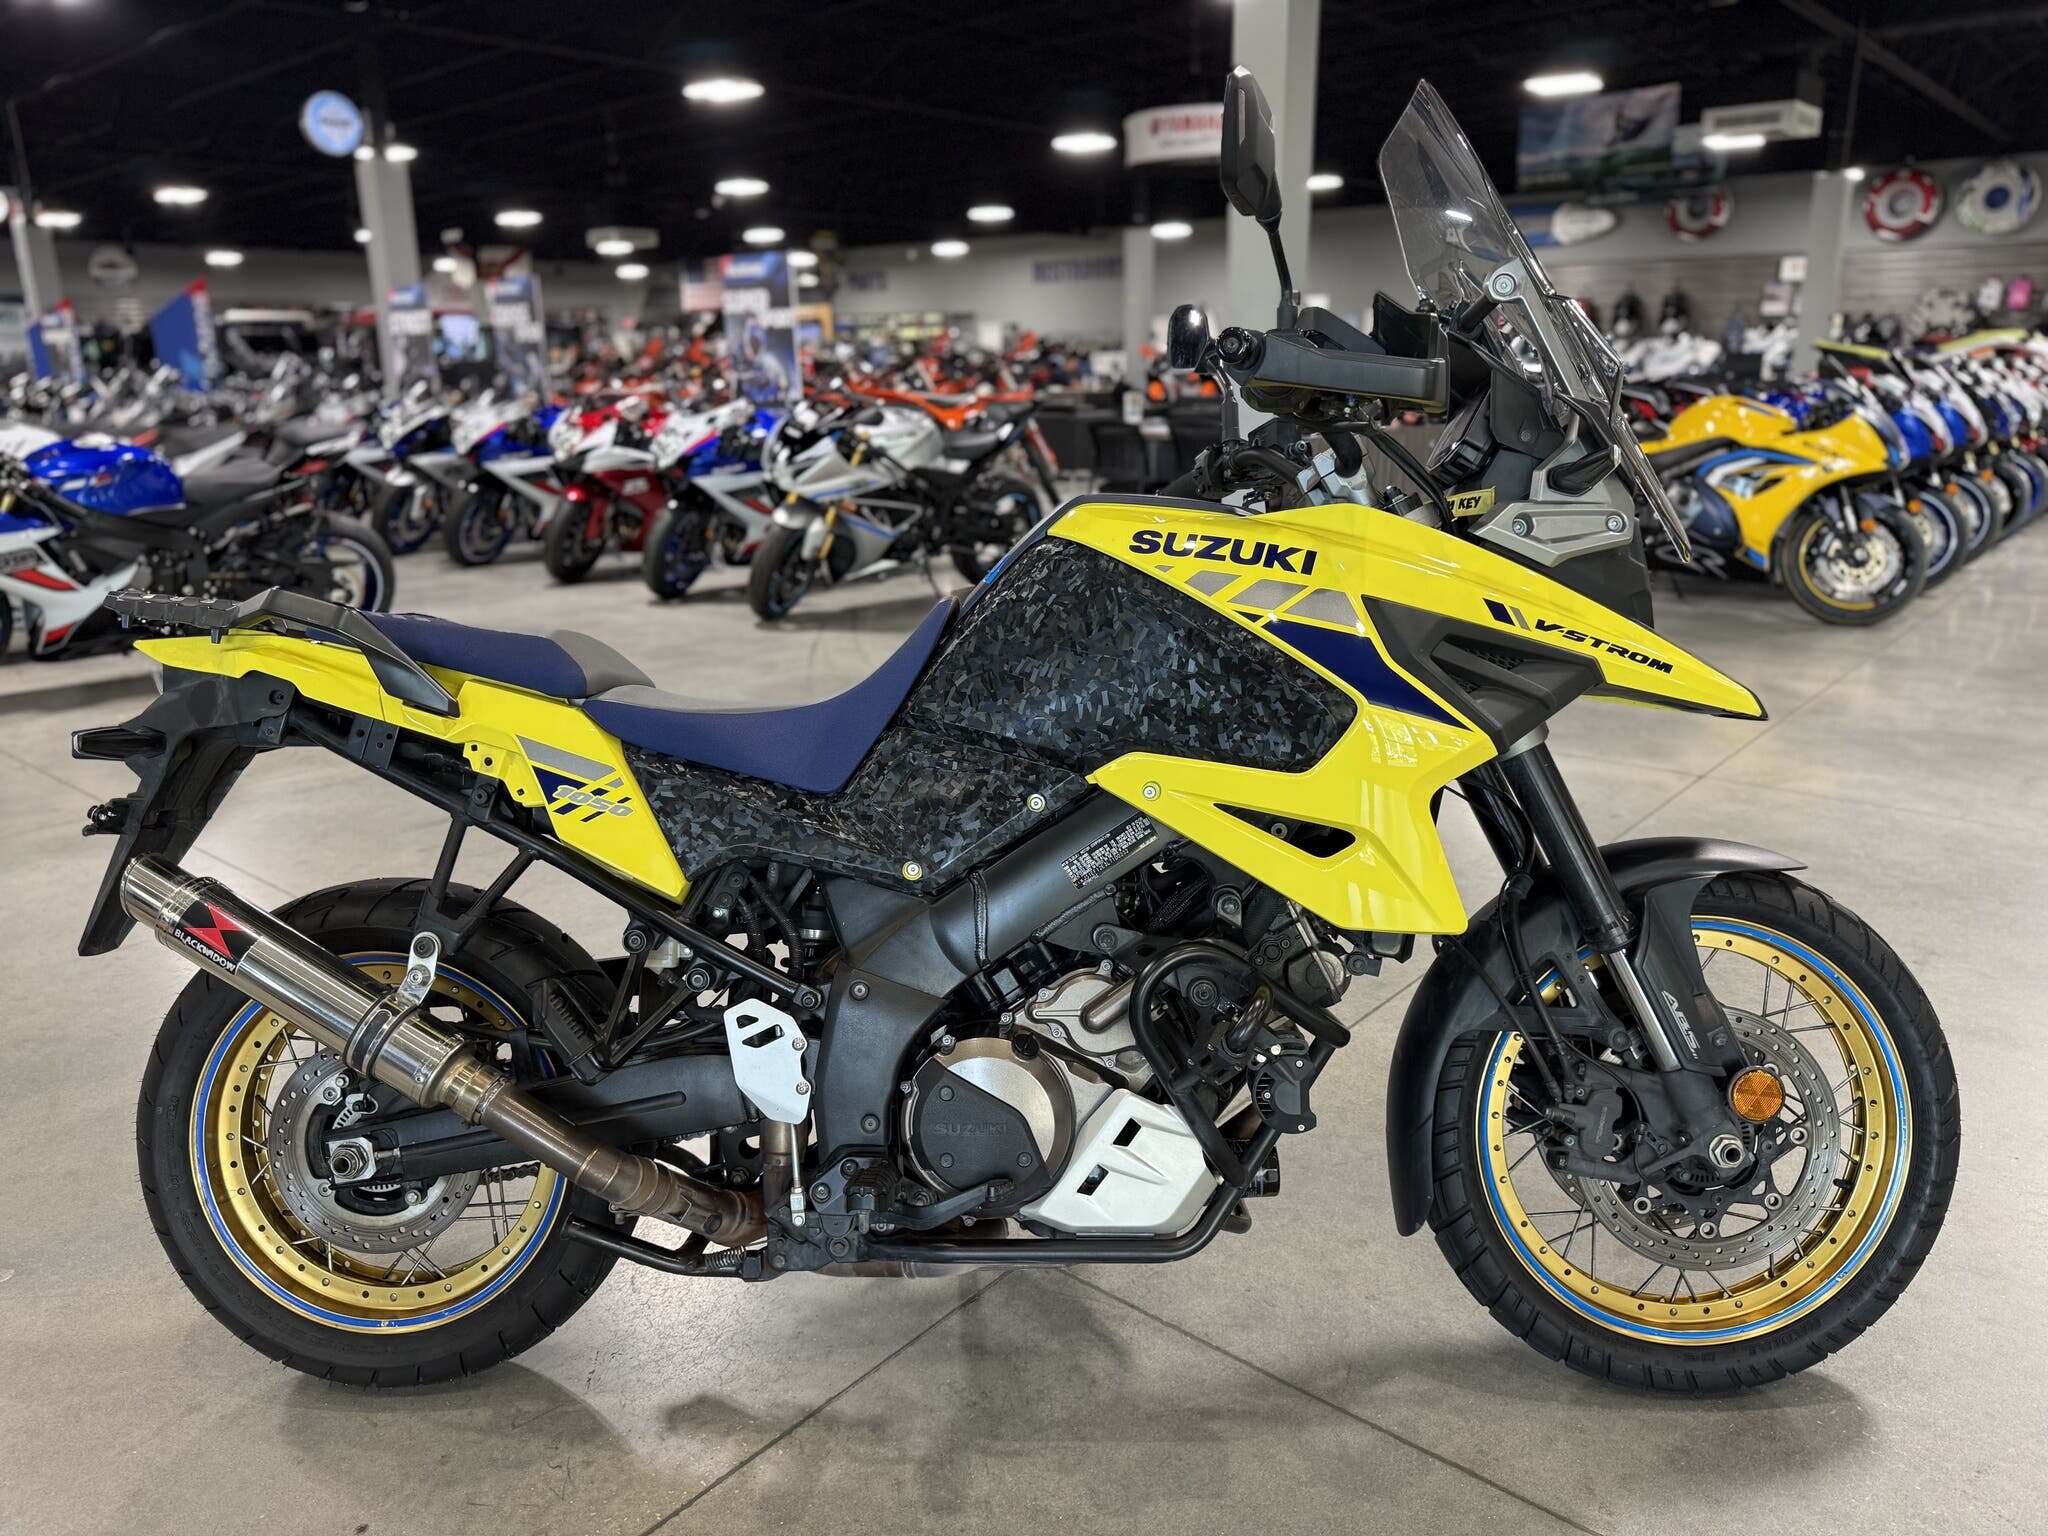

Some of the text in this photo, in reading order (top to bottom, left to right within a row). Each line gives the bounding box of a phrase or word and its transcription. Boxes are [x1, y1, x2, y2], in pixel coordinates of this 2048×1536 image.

[1458, 496, 1481, 510] KEY
[1129, 530, 1318, 576] SUZUKI
[1535, 618, 1673, 674] V-STROM
[552, 785, 634, 817] 1050
[174, 928, 236, 972] BLACKWIDOW
[1661, 990, 1700, 1051] ABS
[934, 1121, 1008, 1137] SUZUKI
